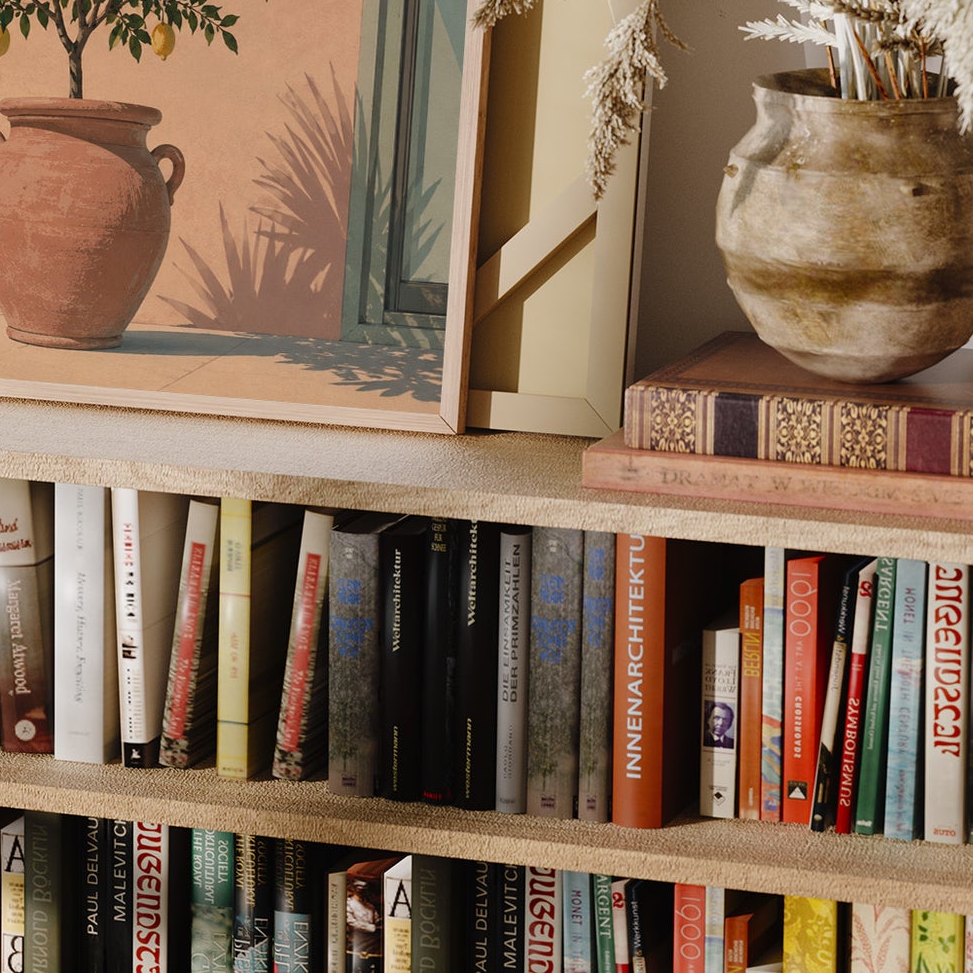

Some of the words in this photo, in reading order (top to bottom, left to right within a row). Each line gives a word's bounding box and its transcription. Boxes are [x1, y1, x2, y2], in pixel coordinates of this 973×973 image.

[6, 578, 23, 640] Margaret
[392, 547, 402, 653] Weltarchitektur
[503, 557, 512, 668] EINSAMKEIT
[510, 544, 521, 660] PRIMZAHLEN
[11, 643, 31, 695] Atwood
[510, 666, 519, 703] DER
[626, 534, 645, 780] INNENARCHITEKTU
[85, 817, 99, 886] DELVAU
[86, 892, 99, 936] PAUL
[570, 890, 583, 926] MONET
[596, 873, 613, 939] ARGENT
[632, 899, 642, 949] Werkkunst
[676, 895, 702, 959] 1900
